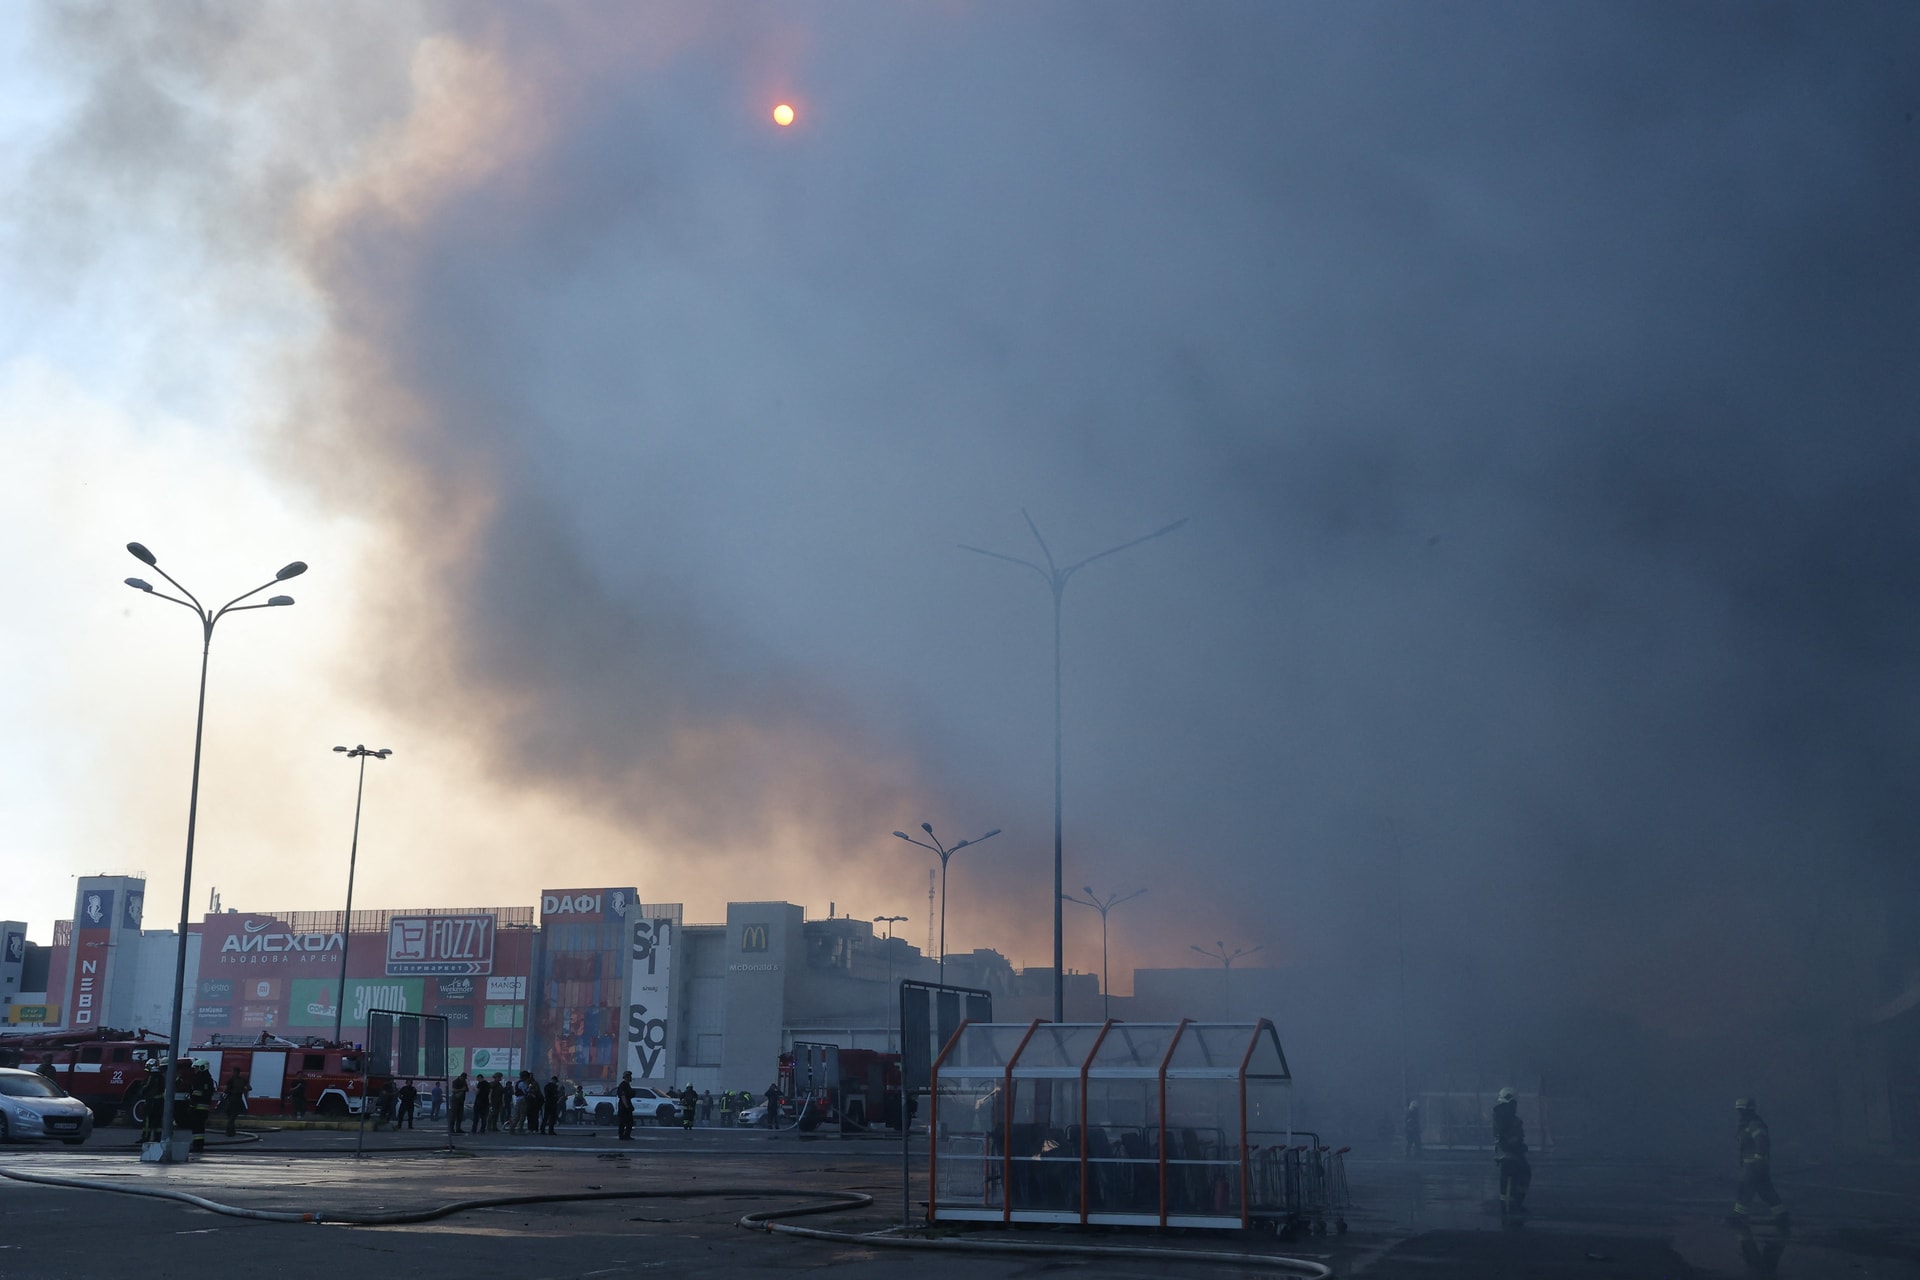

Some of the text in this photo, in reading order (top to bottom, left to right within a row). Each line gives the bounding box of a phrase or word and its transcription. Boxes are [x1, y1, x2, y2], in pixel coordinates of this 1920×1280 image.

[431, 918, 489, 959] FOZZY
[220, 954, 338, 964] ЛЬОДОВА АРЕН
[729, 963, 779, 972] McDonald's
[490, 981, 522, 989] MANGO
[76, 959, 97, 1024] NEBO
[112, 1070, 123, 1080] 22
